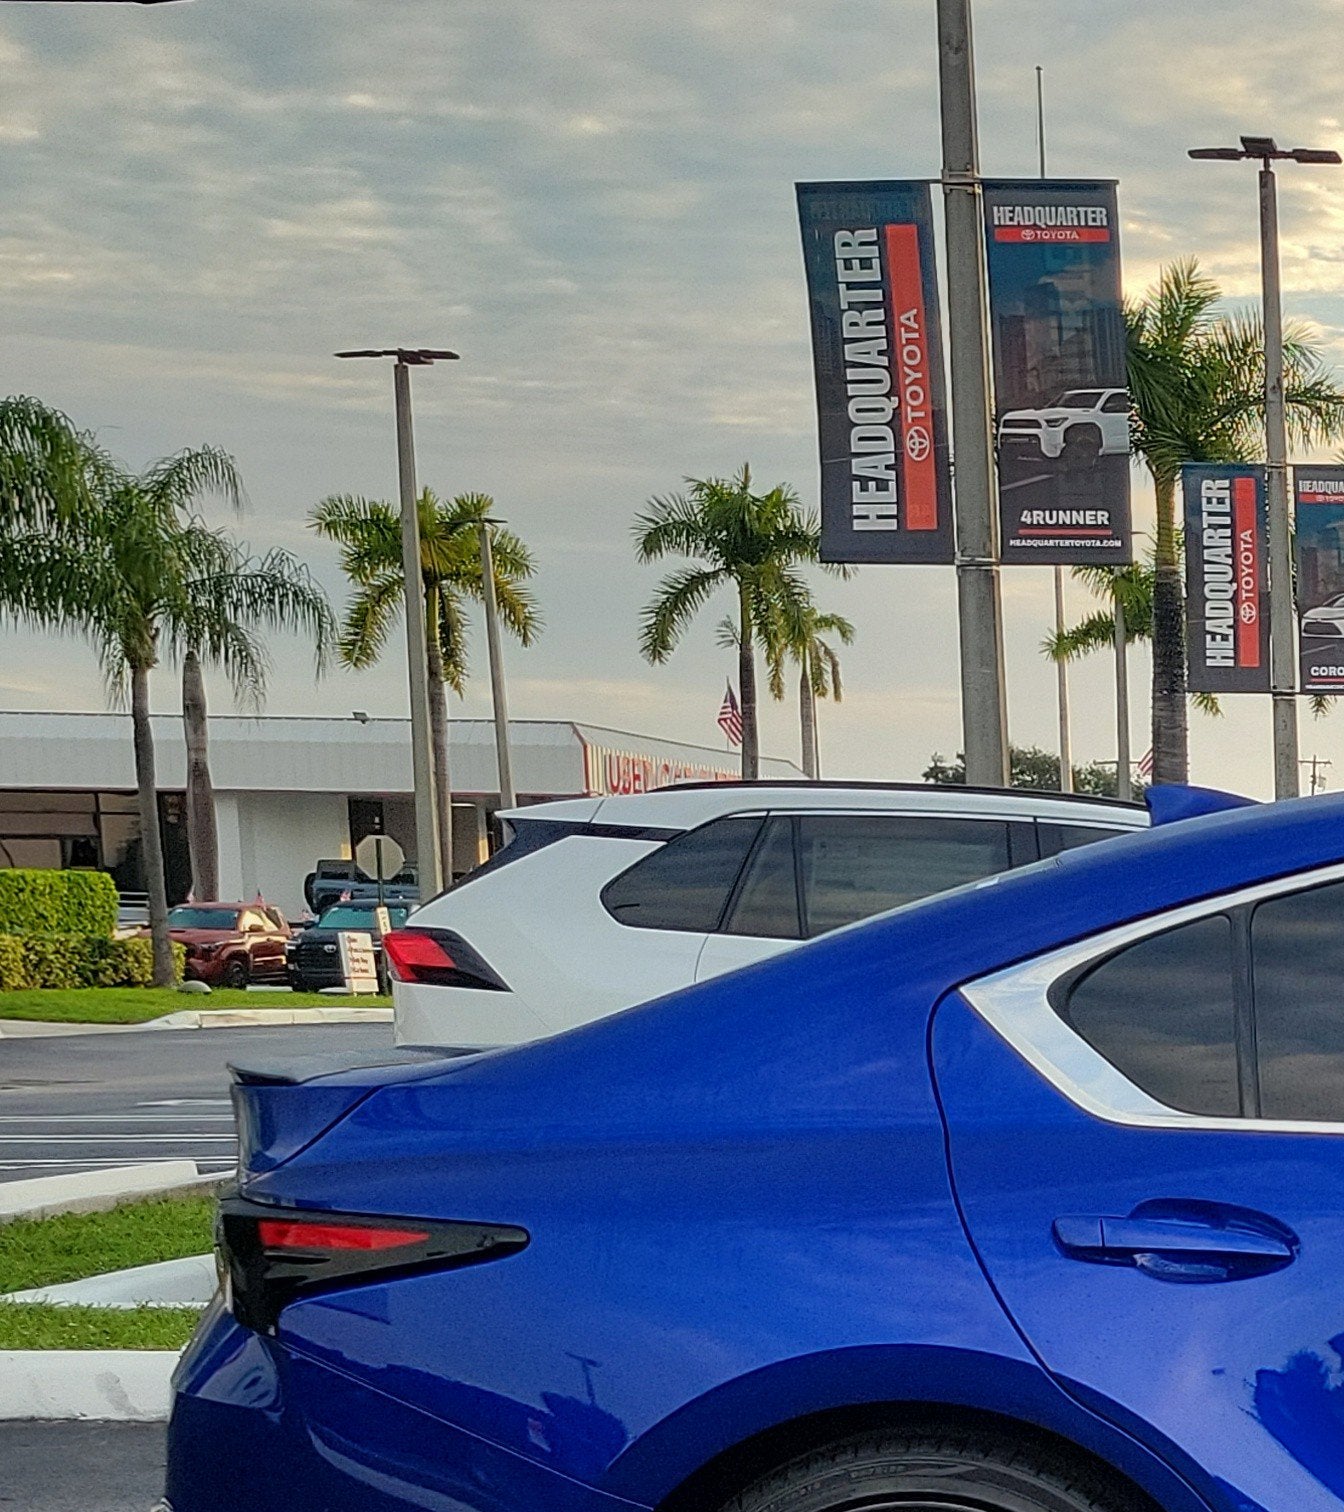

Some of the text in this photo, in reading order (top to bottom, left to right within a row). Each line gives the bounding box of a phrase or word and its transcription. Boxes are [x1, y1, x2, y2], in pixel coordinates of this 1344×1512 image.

[992, 206, 1108, 228] HEADQUARTER
[1036, 230, 1080, 239] TOYOTA
[834, 228, 899, 531] HEADQUARTER
[900, 308, 926, 423] TOYOTA
[1020, 510, 1110, 525] 4RUNNER
[1201, 479, 1237, 667] HEADQUARTER
[1240, 529, 1254, 600] TOYOTA
